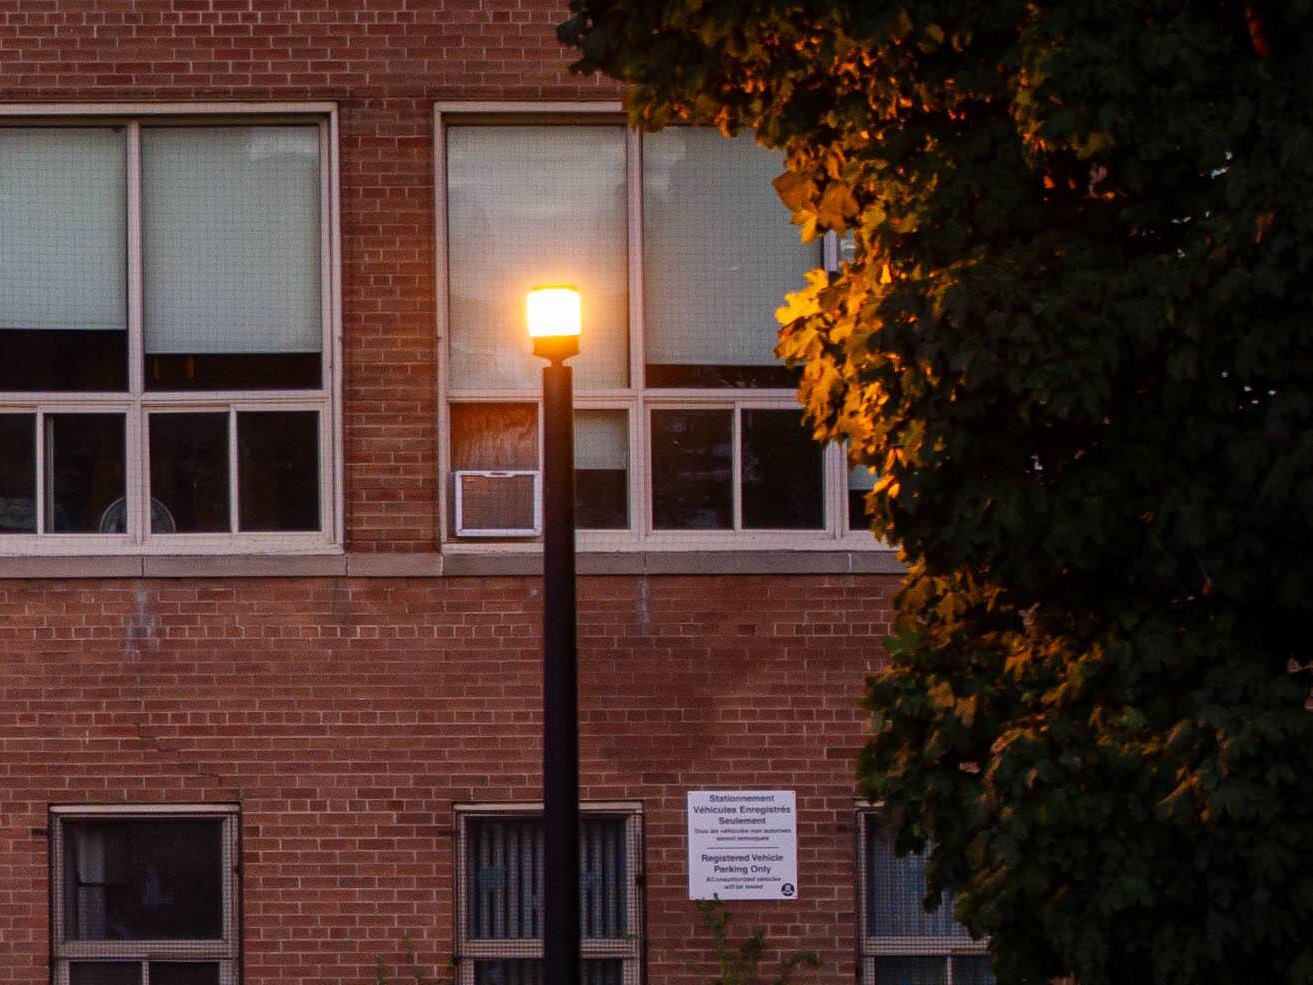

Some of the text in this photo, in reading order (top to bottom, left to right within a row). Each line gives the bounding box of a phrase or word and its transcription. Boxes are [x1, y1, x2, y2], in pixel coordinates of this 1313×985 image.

[709, 794, 775, 803] Stationnement
[693, 806, 791, 816] Véhicules Enregistrés
[718, 817, 766, 825] Seulement
[701, 854, 784, 864] Registered Vehicle
[714, 865, 772, 875] Parking Only
